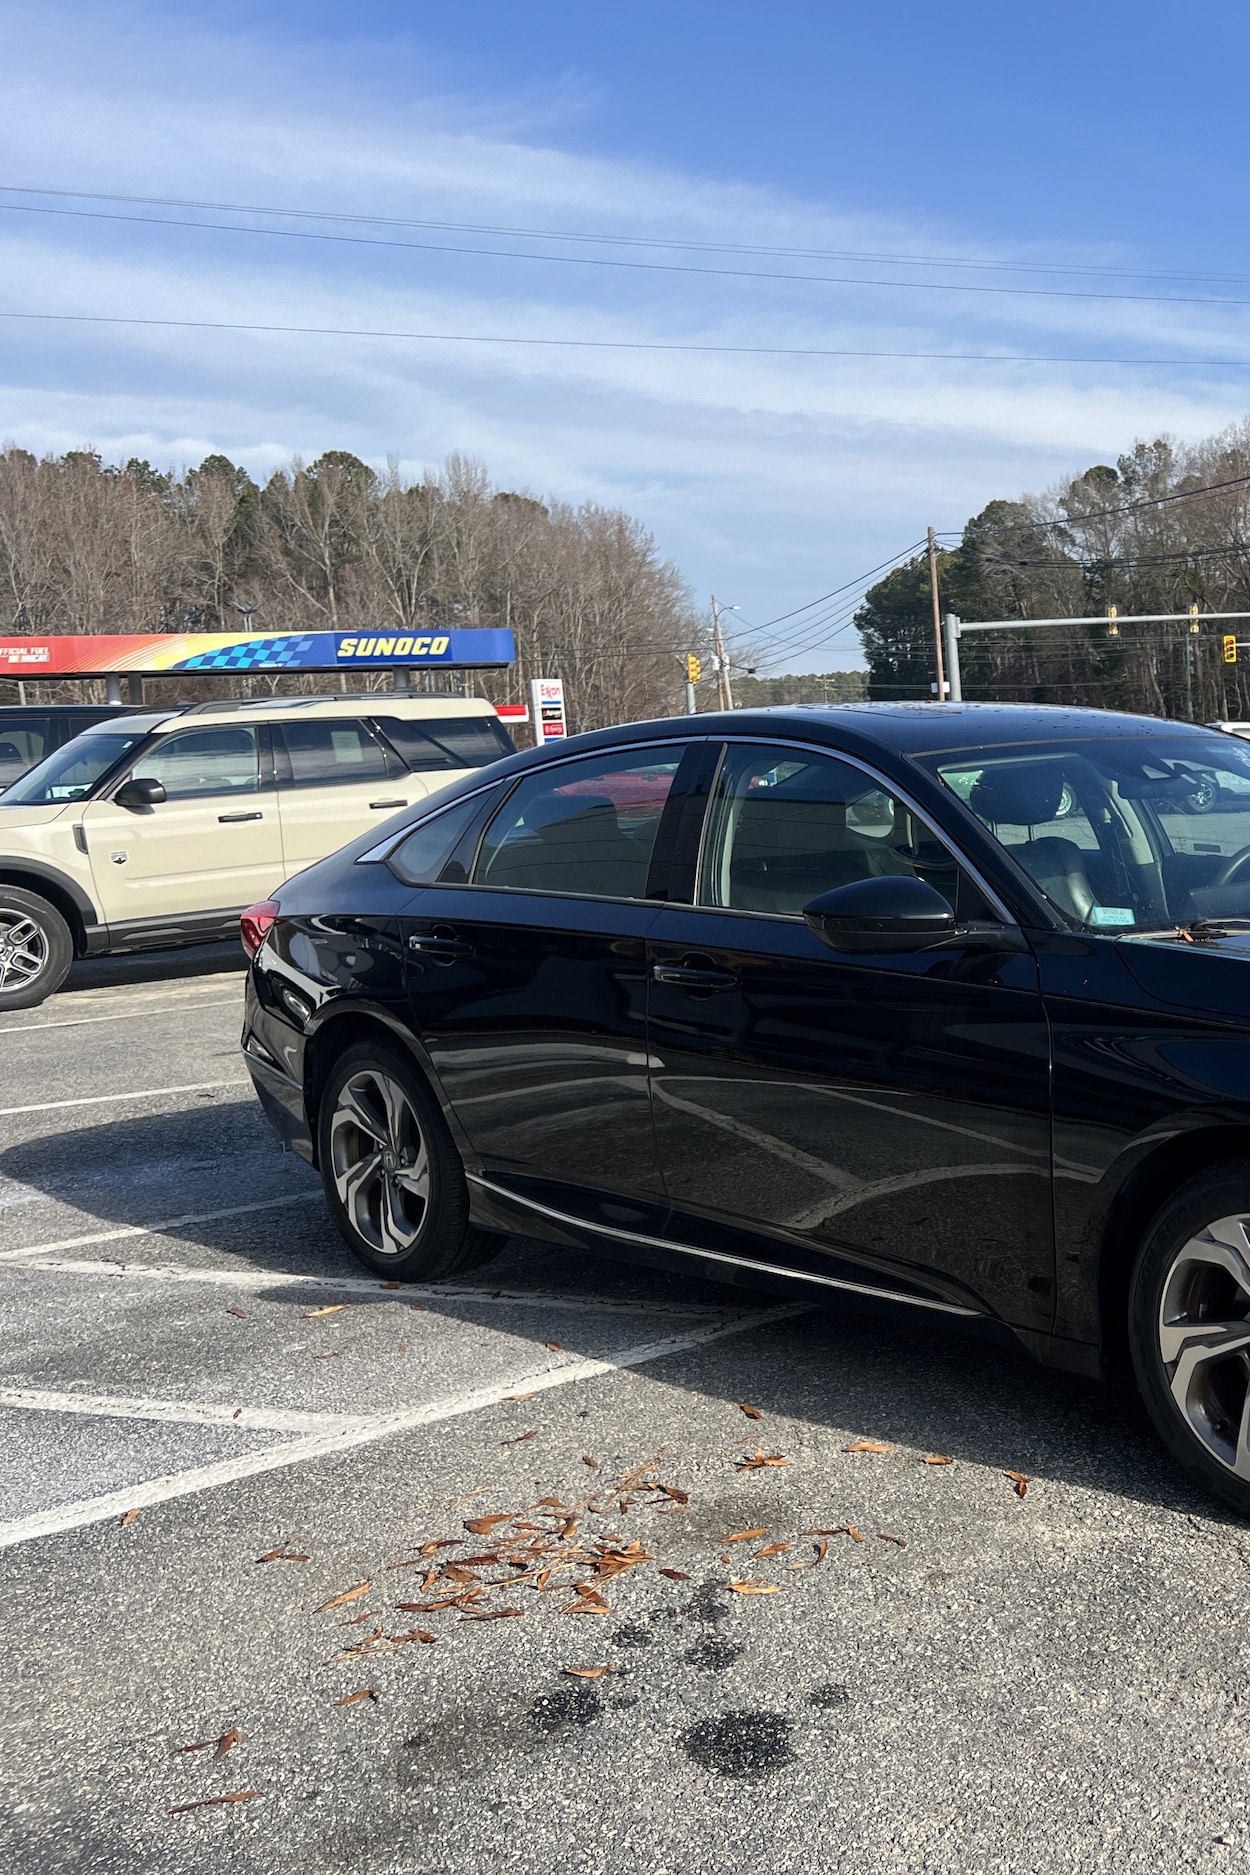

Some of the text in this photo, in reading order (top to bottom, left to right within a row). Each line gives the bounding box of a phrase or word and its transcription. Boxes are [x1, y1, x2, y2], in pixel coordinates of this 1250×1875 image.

[0, 646, 50, 655] FFICIAL FUEL
[337, 636, 450, 657] SUNOCO
